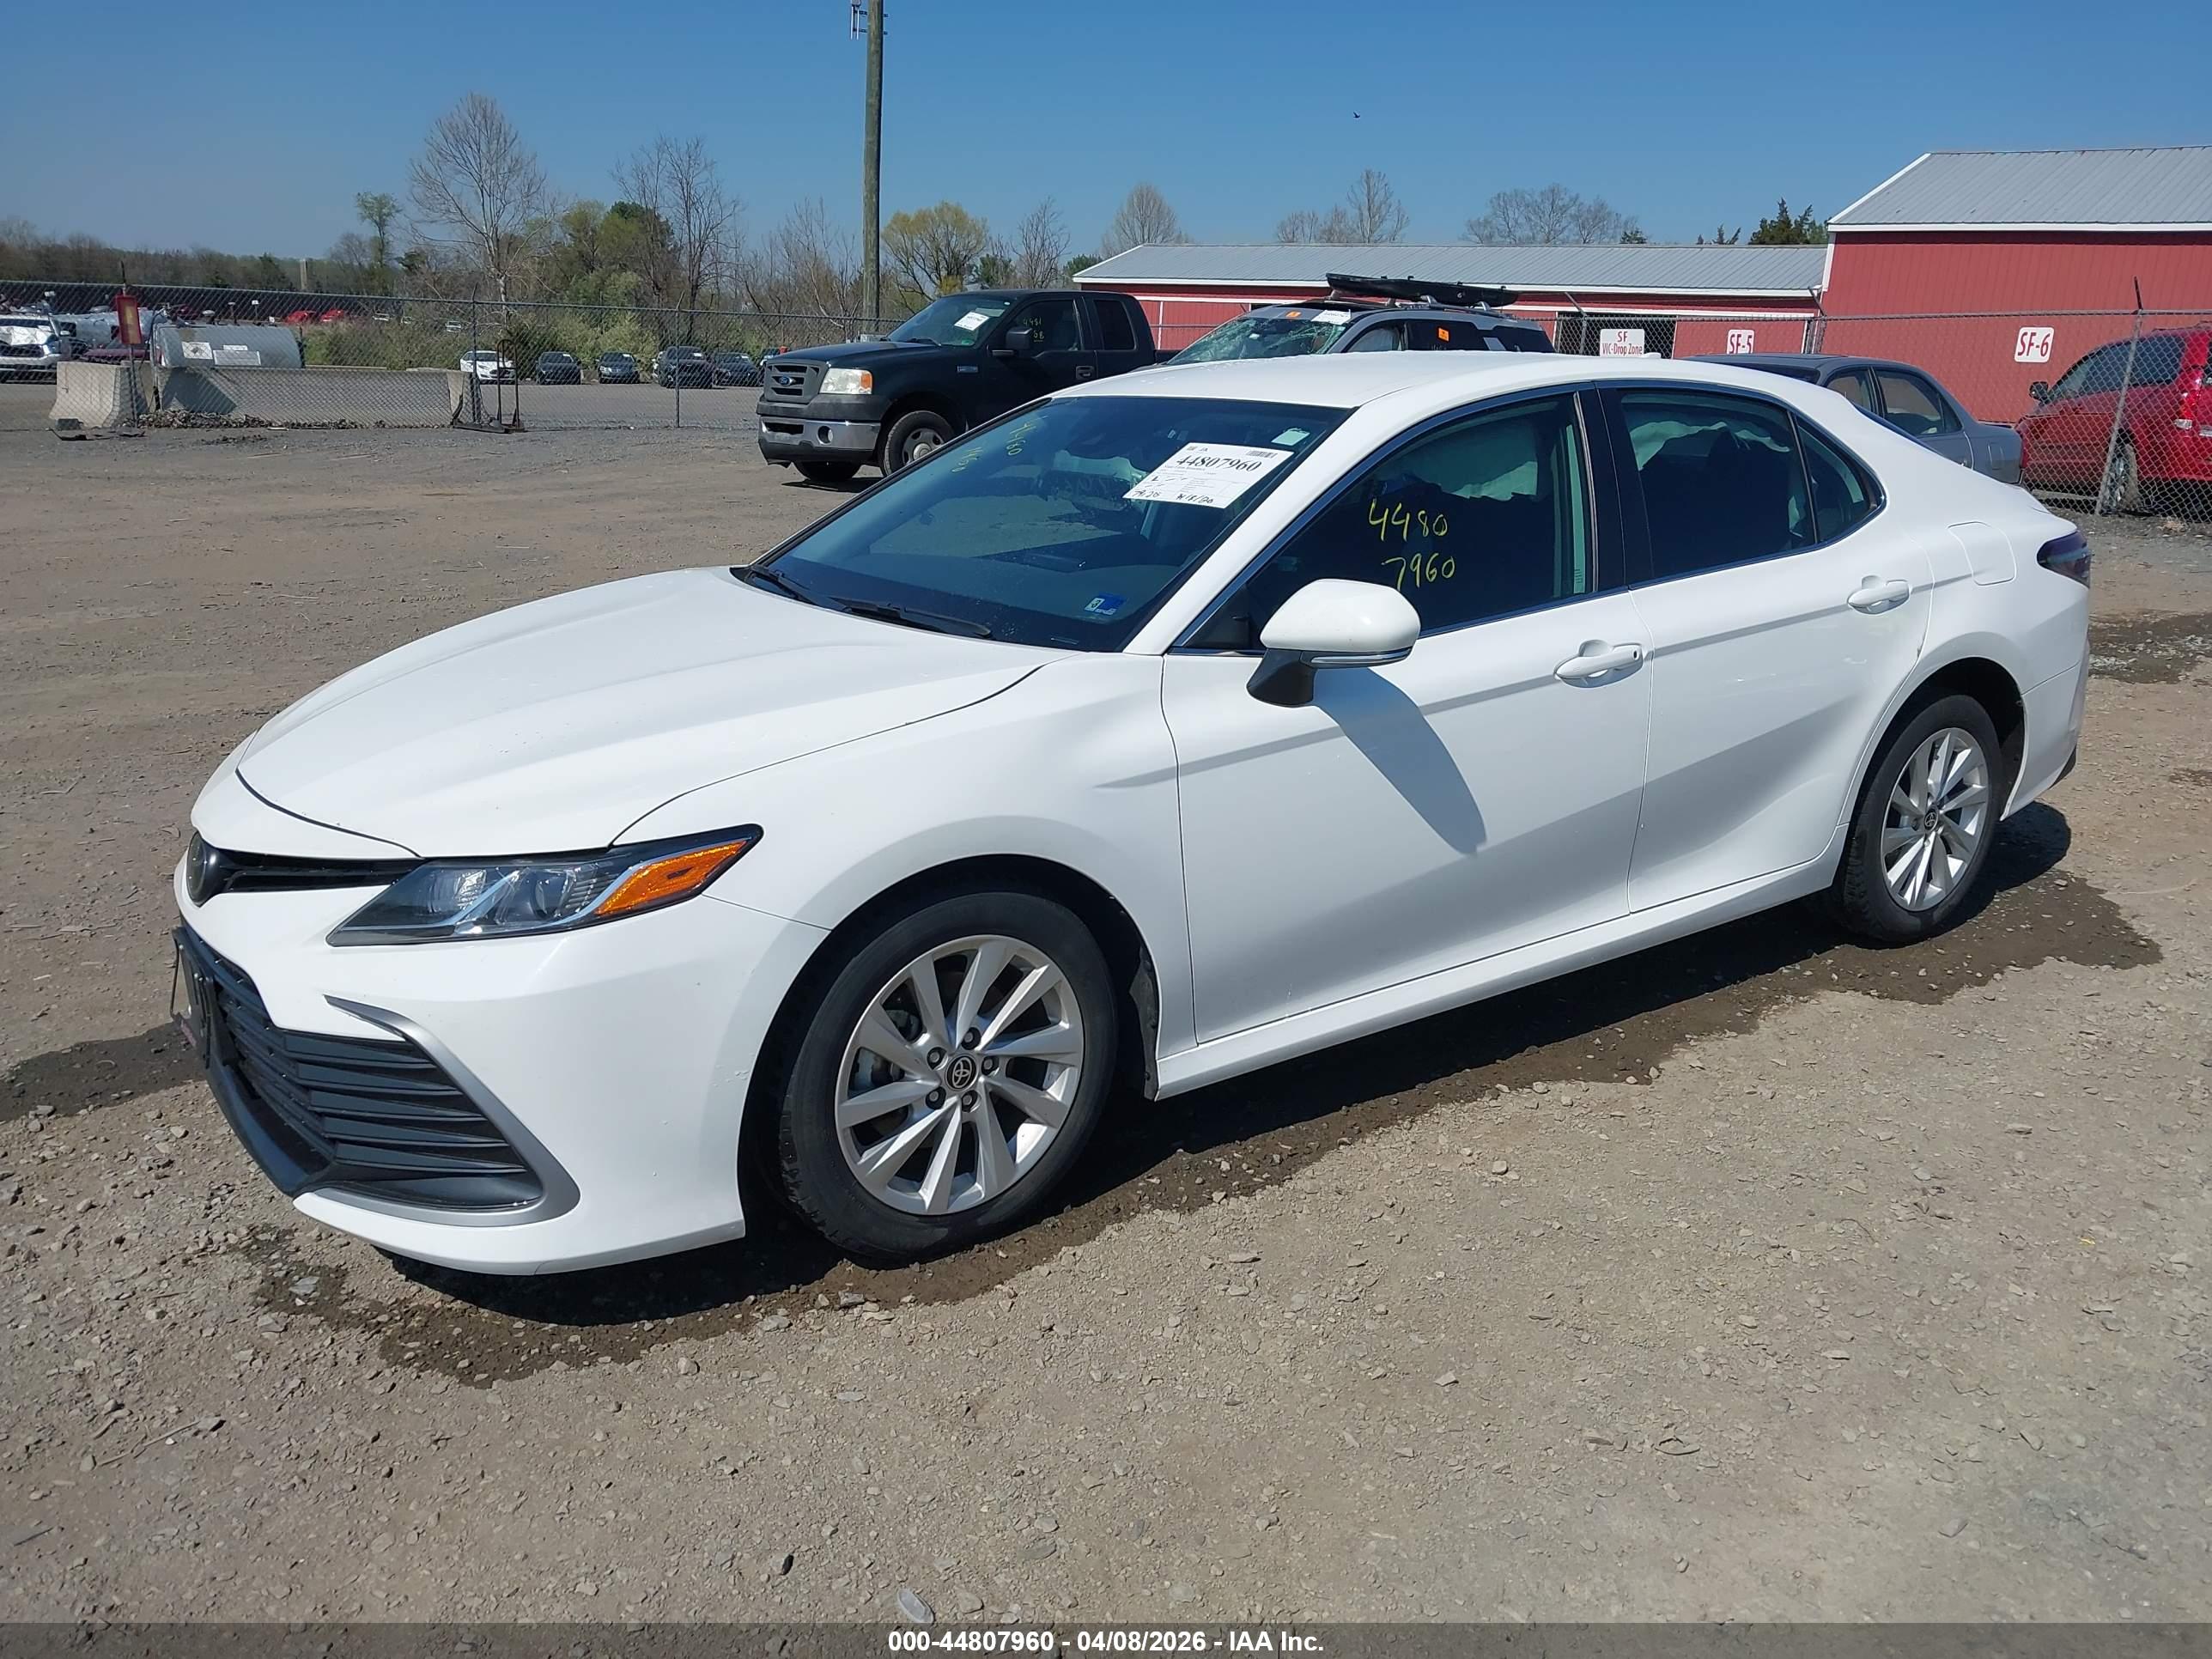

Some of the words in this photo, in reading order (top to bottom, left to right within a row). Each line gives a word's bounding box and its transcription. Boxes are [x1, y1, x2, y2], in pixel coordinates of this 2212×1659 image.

[1617, 331, 1628, 343] SF
[1729, 333, 1753, 354] SF-5
[2017, 331, 2051, 357] SF-6
[1176, 454, 1262, 472] 44807960
[1368, 498, 1448, 542] 4480
[1381, 553, 1455, 591] 7960
